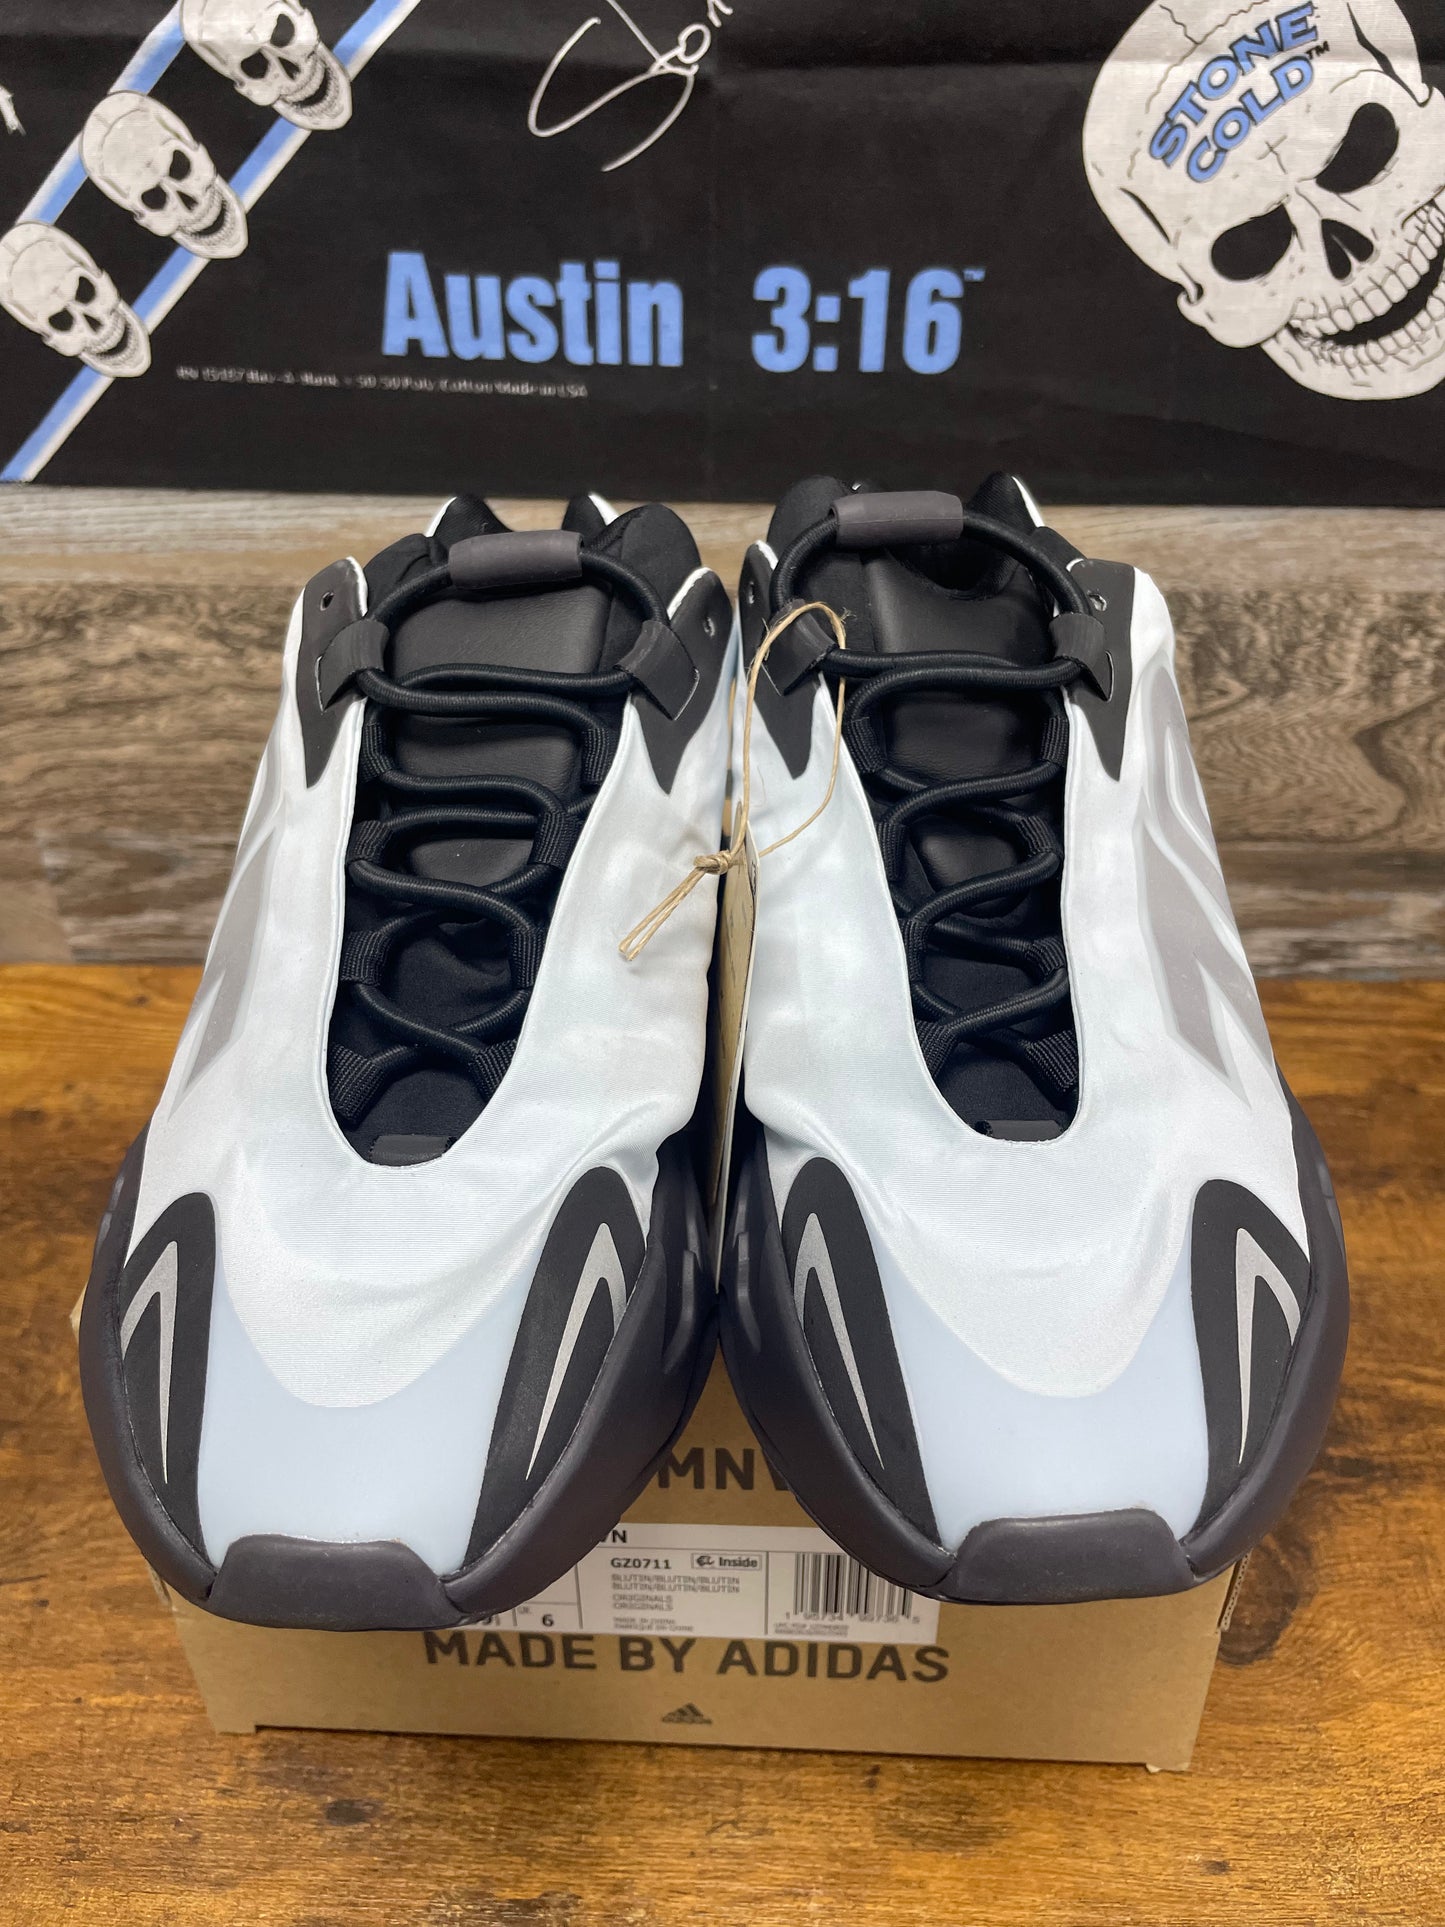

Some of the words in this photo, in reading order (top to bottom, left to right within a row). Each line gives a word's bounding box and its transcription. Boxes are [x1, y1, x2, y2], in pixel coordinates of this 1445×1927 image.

[1149, 1, 1318, 168] STONE
[1186, 55, 1314, 183] COLD
[381, 250, 684, 369] Austin
[658, 1447, 791, 1491] MN
[611, 1557, 672, 1570] GZ0711
[719, 1556, 758, 1568] Inside
[541, 1614, 555, 1628] 6
[423, 1631, 597, 1670] MADE
[620, 1637, 697, 1674] BY
[716, 1640, 950, 1683] ADIDAS
